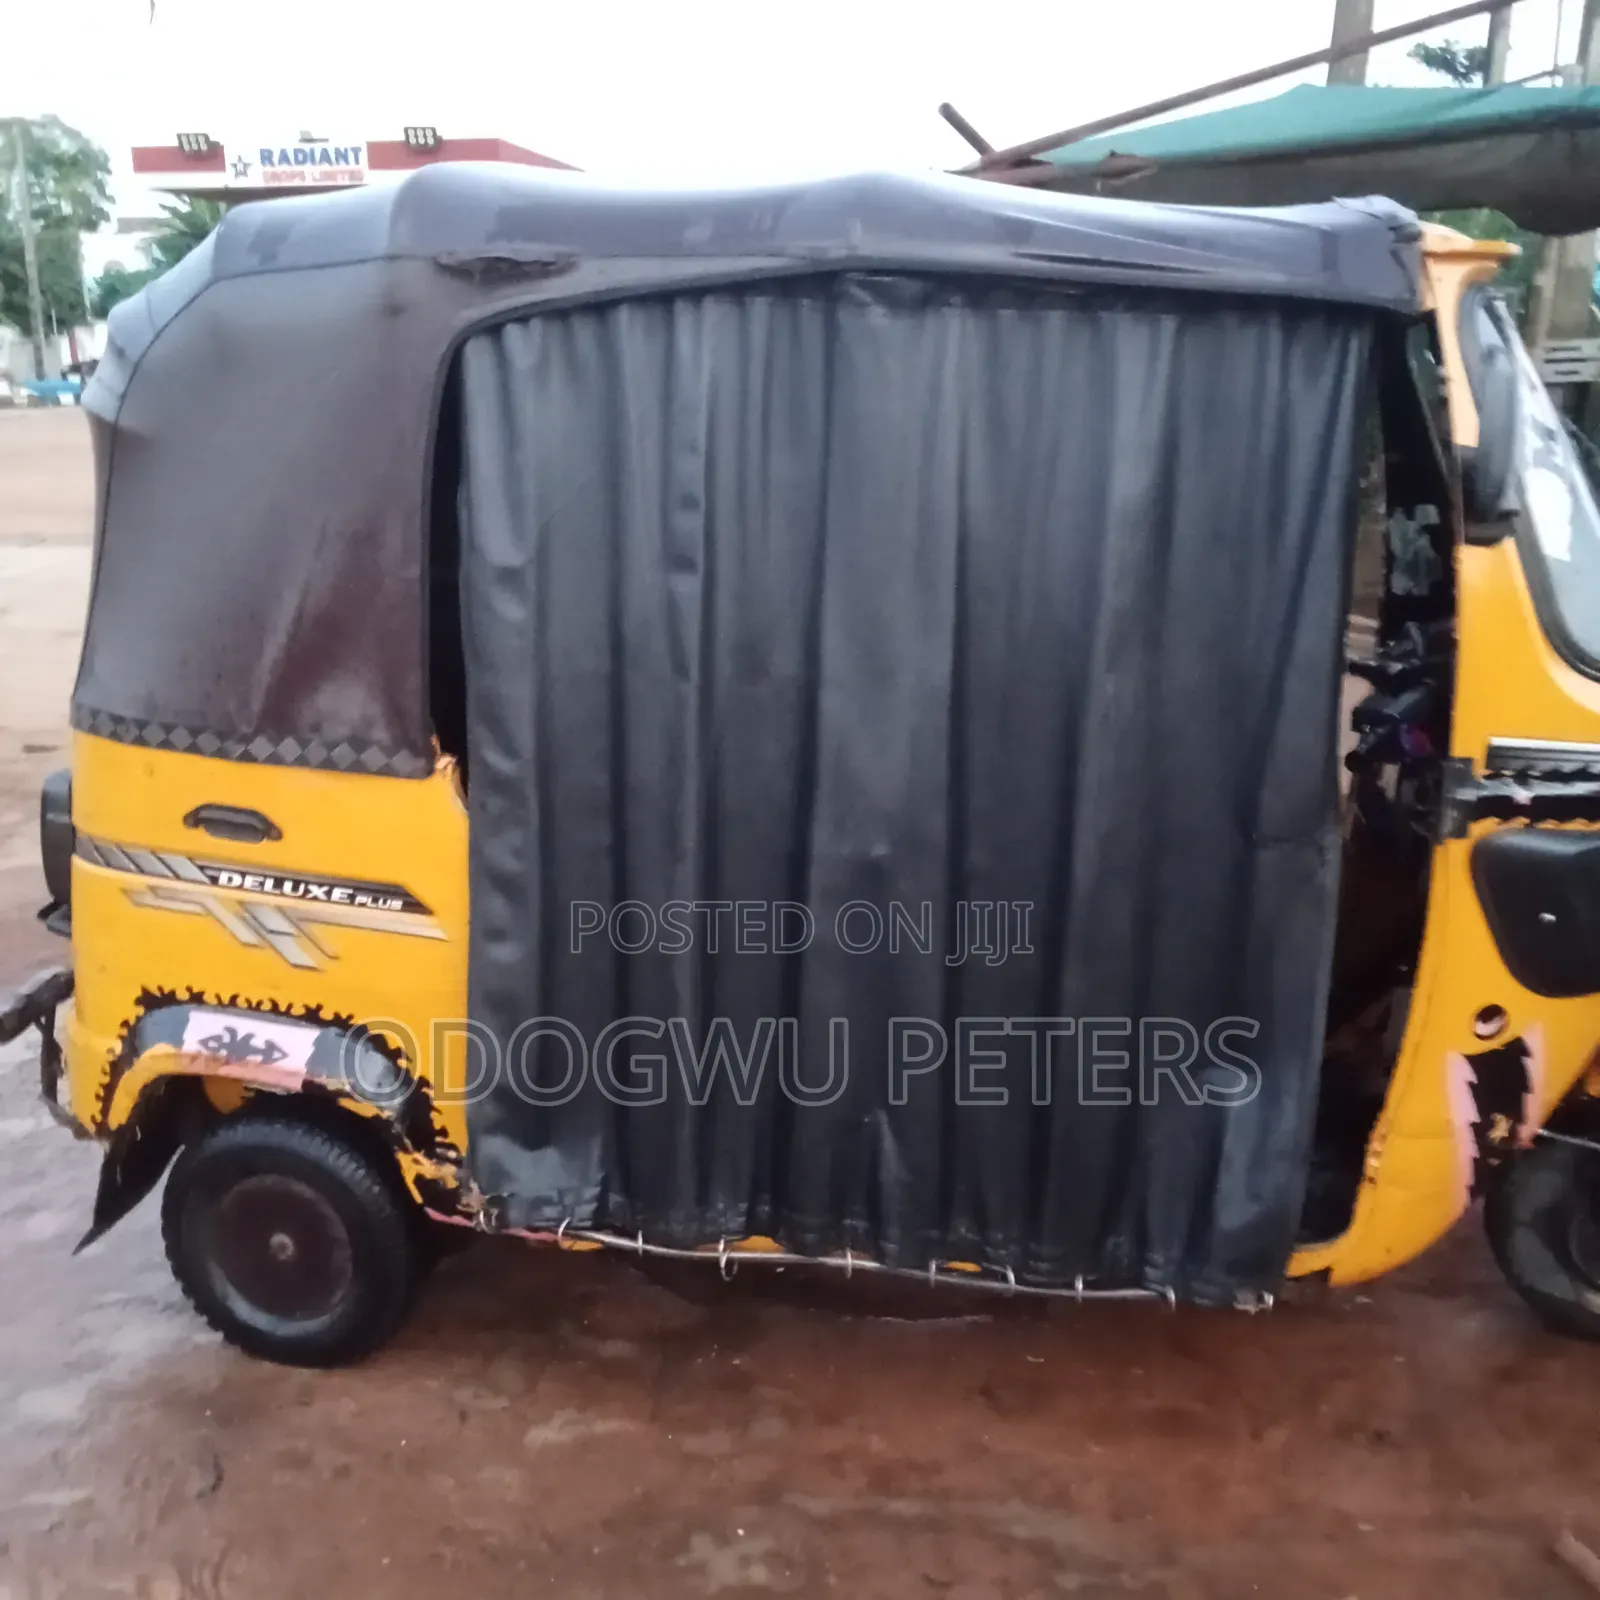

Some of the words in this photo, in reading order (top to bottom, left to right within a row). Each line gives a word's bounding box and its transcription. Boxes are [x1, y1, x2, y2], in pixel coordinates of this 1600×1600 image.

[259, 147, 361, 167] RADIANT
[218, 870, 353, 903] DELUXE
[354, 896, 403, 911] PLUS
